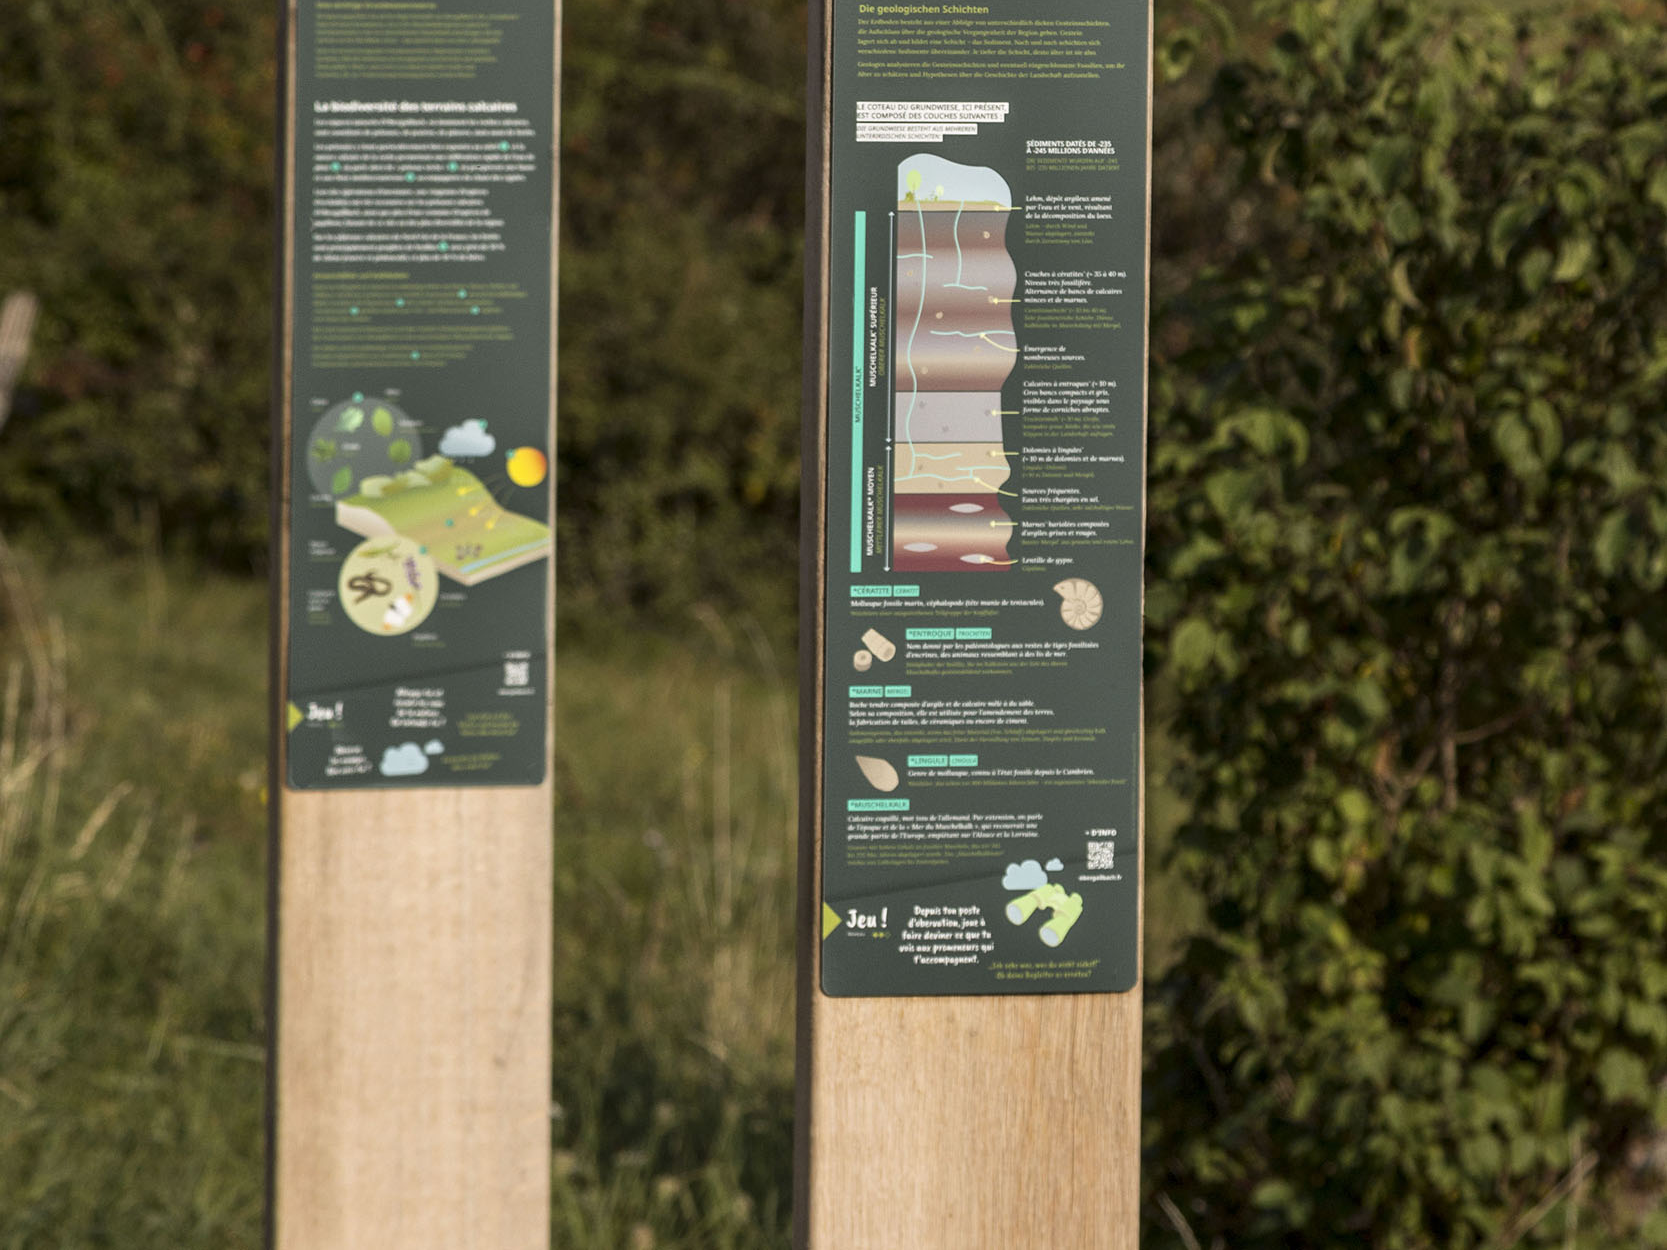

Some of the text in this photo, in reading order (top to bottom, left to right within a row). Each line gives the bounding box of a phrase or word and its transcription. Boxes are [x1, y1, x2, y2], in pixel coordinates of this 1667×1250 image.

[859, 4, 989, 16] Die geologischen Schichten
[867, 103, 896, 111] COTEAU
[897, 104, 909, 113] DU
[974, 104, 1007, 112] PRÉSENT,
[857, 112, 870, 120] EST
[871, 112, 907, 120] COMPOSÉ
[908, 112, 922, 120] DES
[913, 905, 941, 918] Depuis
[958, 905, 980, 918] poste
[846, 907, 888, 929] Jeu !
[961, 918, 979, 929] joue
[980, 918, 986, 927] à
[902, 930, 992, 941] faire deviner ce que tu
[898, 942, 994, 954] vois aux promeneurs qui
